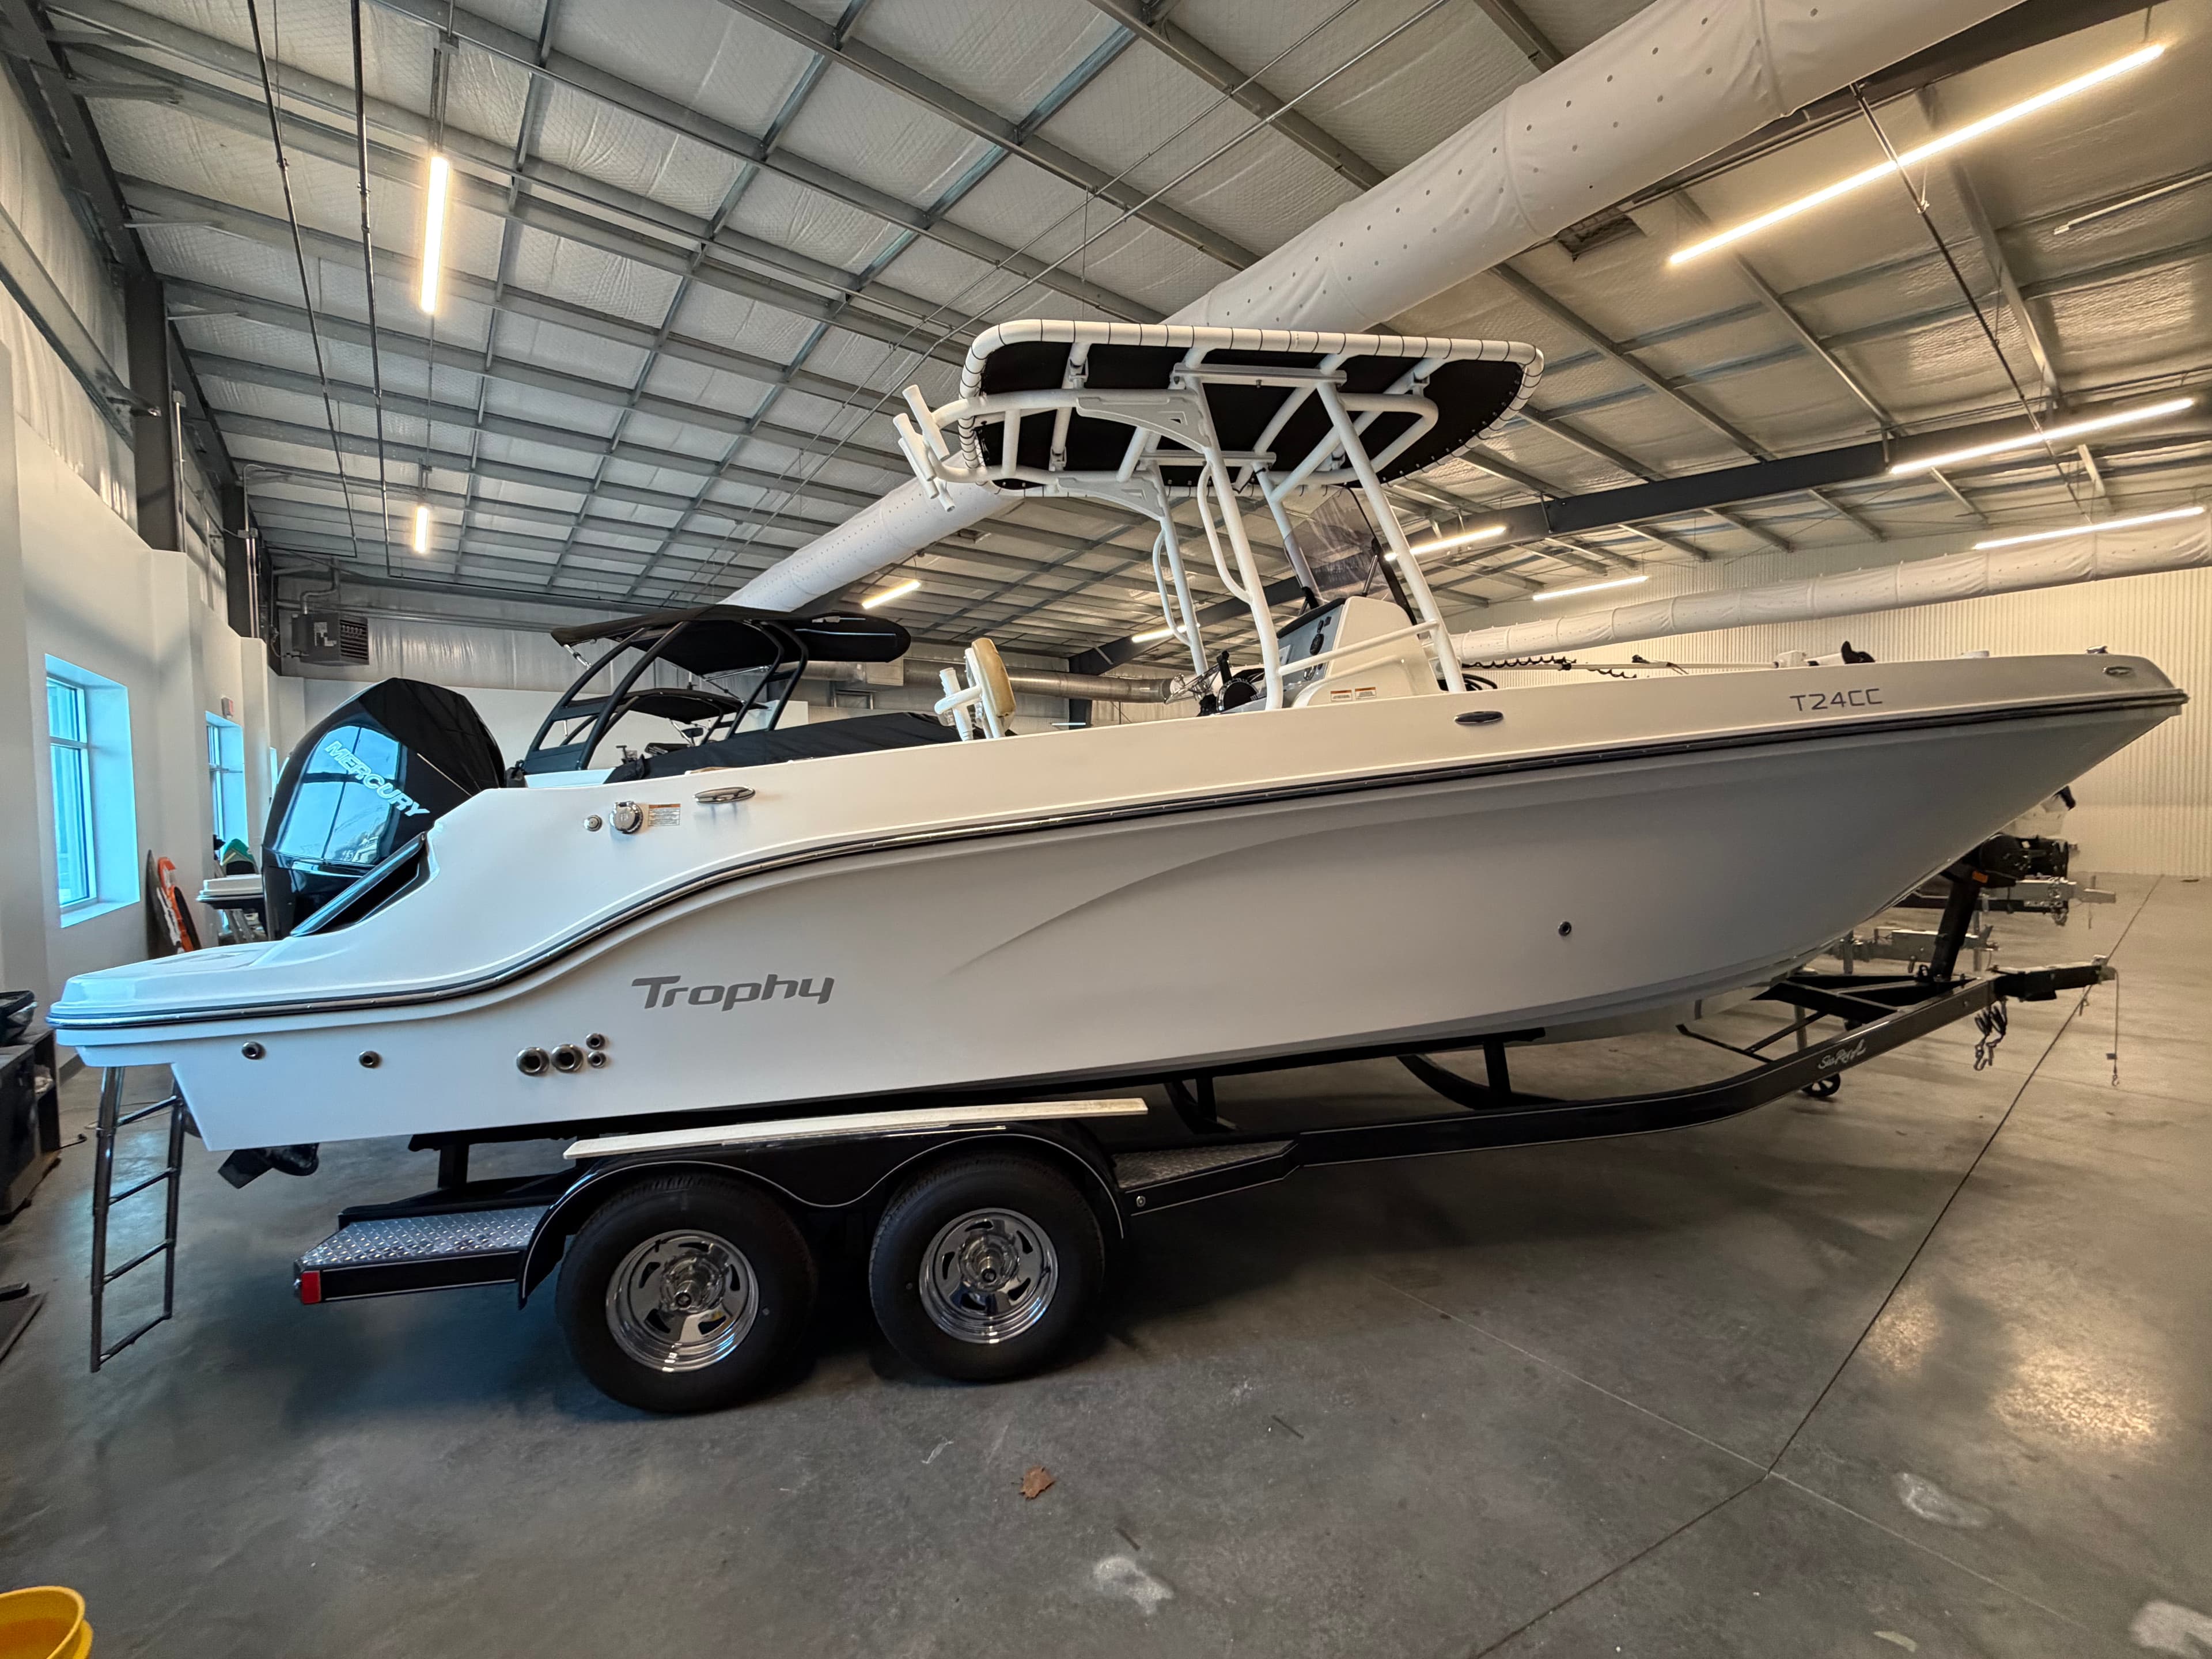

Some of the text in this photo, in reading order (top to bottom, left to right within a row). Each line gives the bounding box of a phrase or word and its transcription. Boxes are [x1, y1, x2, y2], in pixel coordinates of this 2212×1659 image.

[1790, 688, 1883, 711] T24CC
[325, 741, 430, 816] MERCURY
[632, 974, 834, 1012] Trophy
